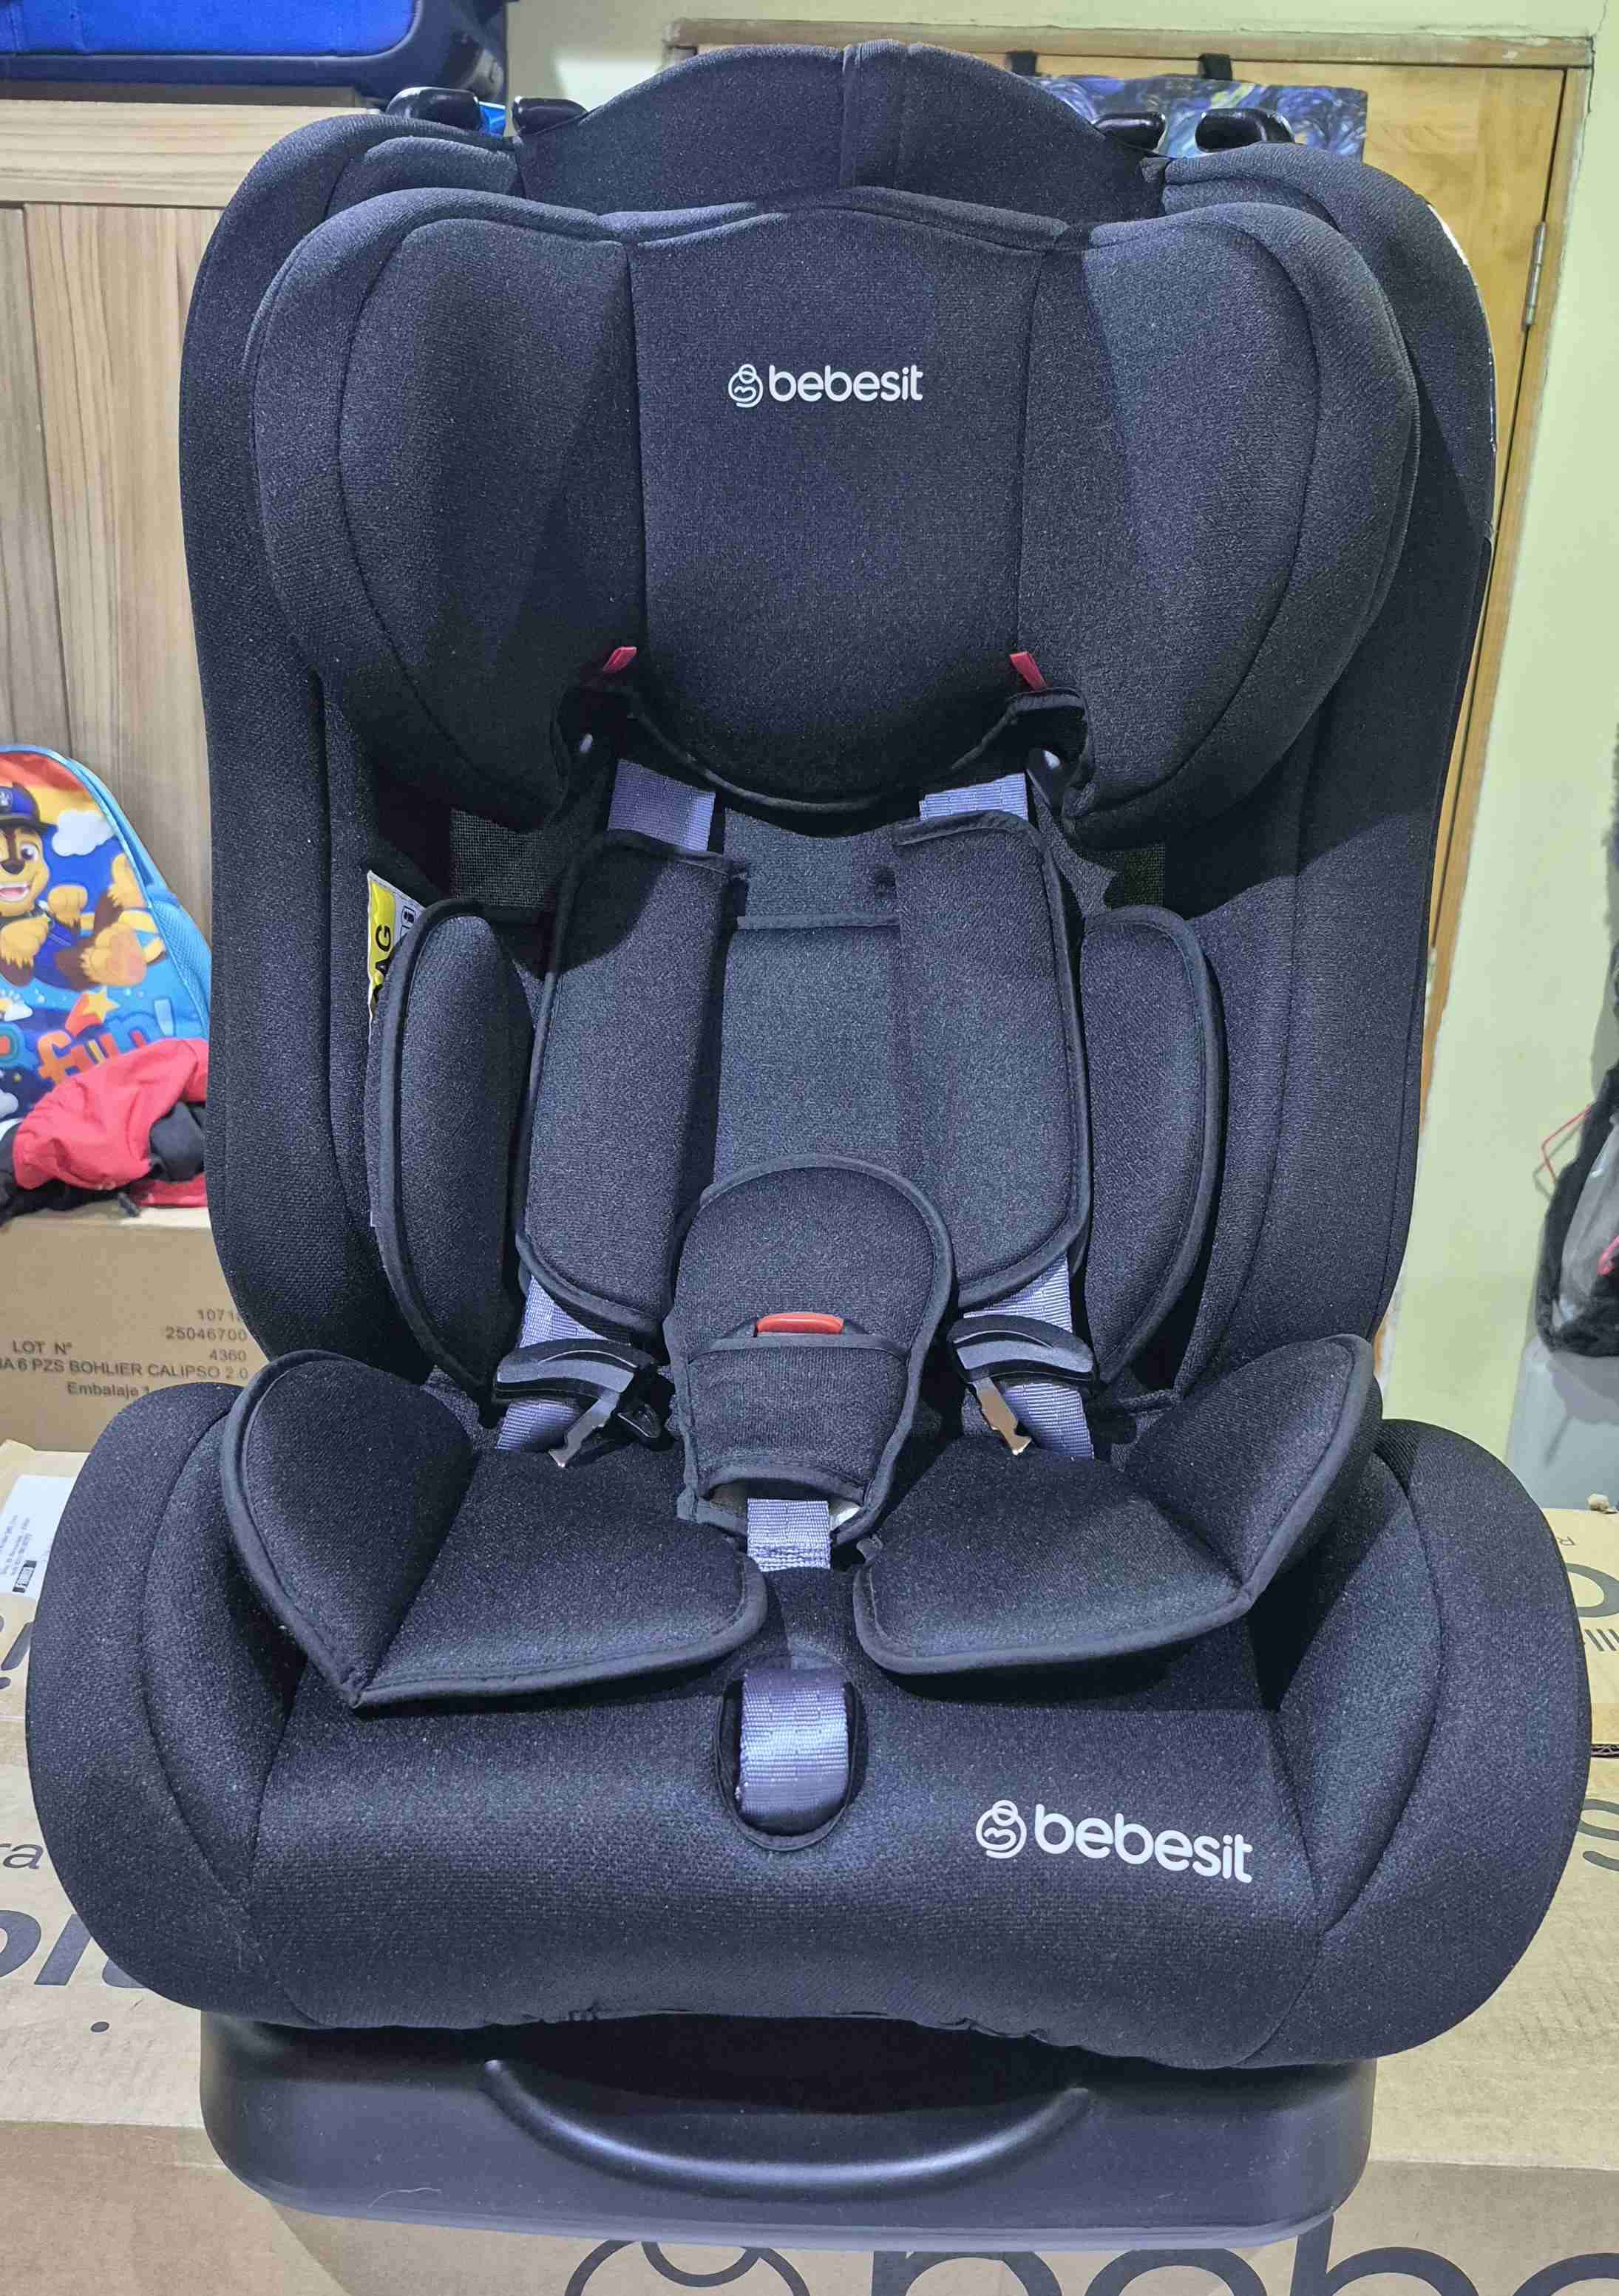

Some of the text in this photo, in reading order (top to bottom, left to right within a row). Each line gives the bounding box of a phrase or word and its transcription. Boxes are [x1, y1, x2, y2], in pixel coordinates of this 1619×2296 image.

[769, 364, 923, 402] bebesit
[196, 1308, 243, 1322] 1071
[165, 1325, 248, 1341] 25046700
[12, 1340, 45, 1354] LOT
[32, 1358, 64, 1373] PZS
[69, 1359, 142, 1376] BOHLIER
[148, 1363, 220, 1379] CALIPSO
[67, 1381, 139, 1400] Embalaje
[1035, 1803, 1253, 1884] bebesit
